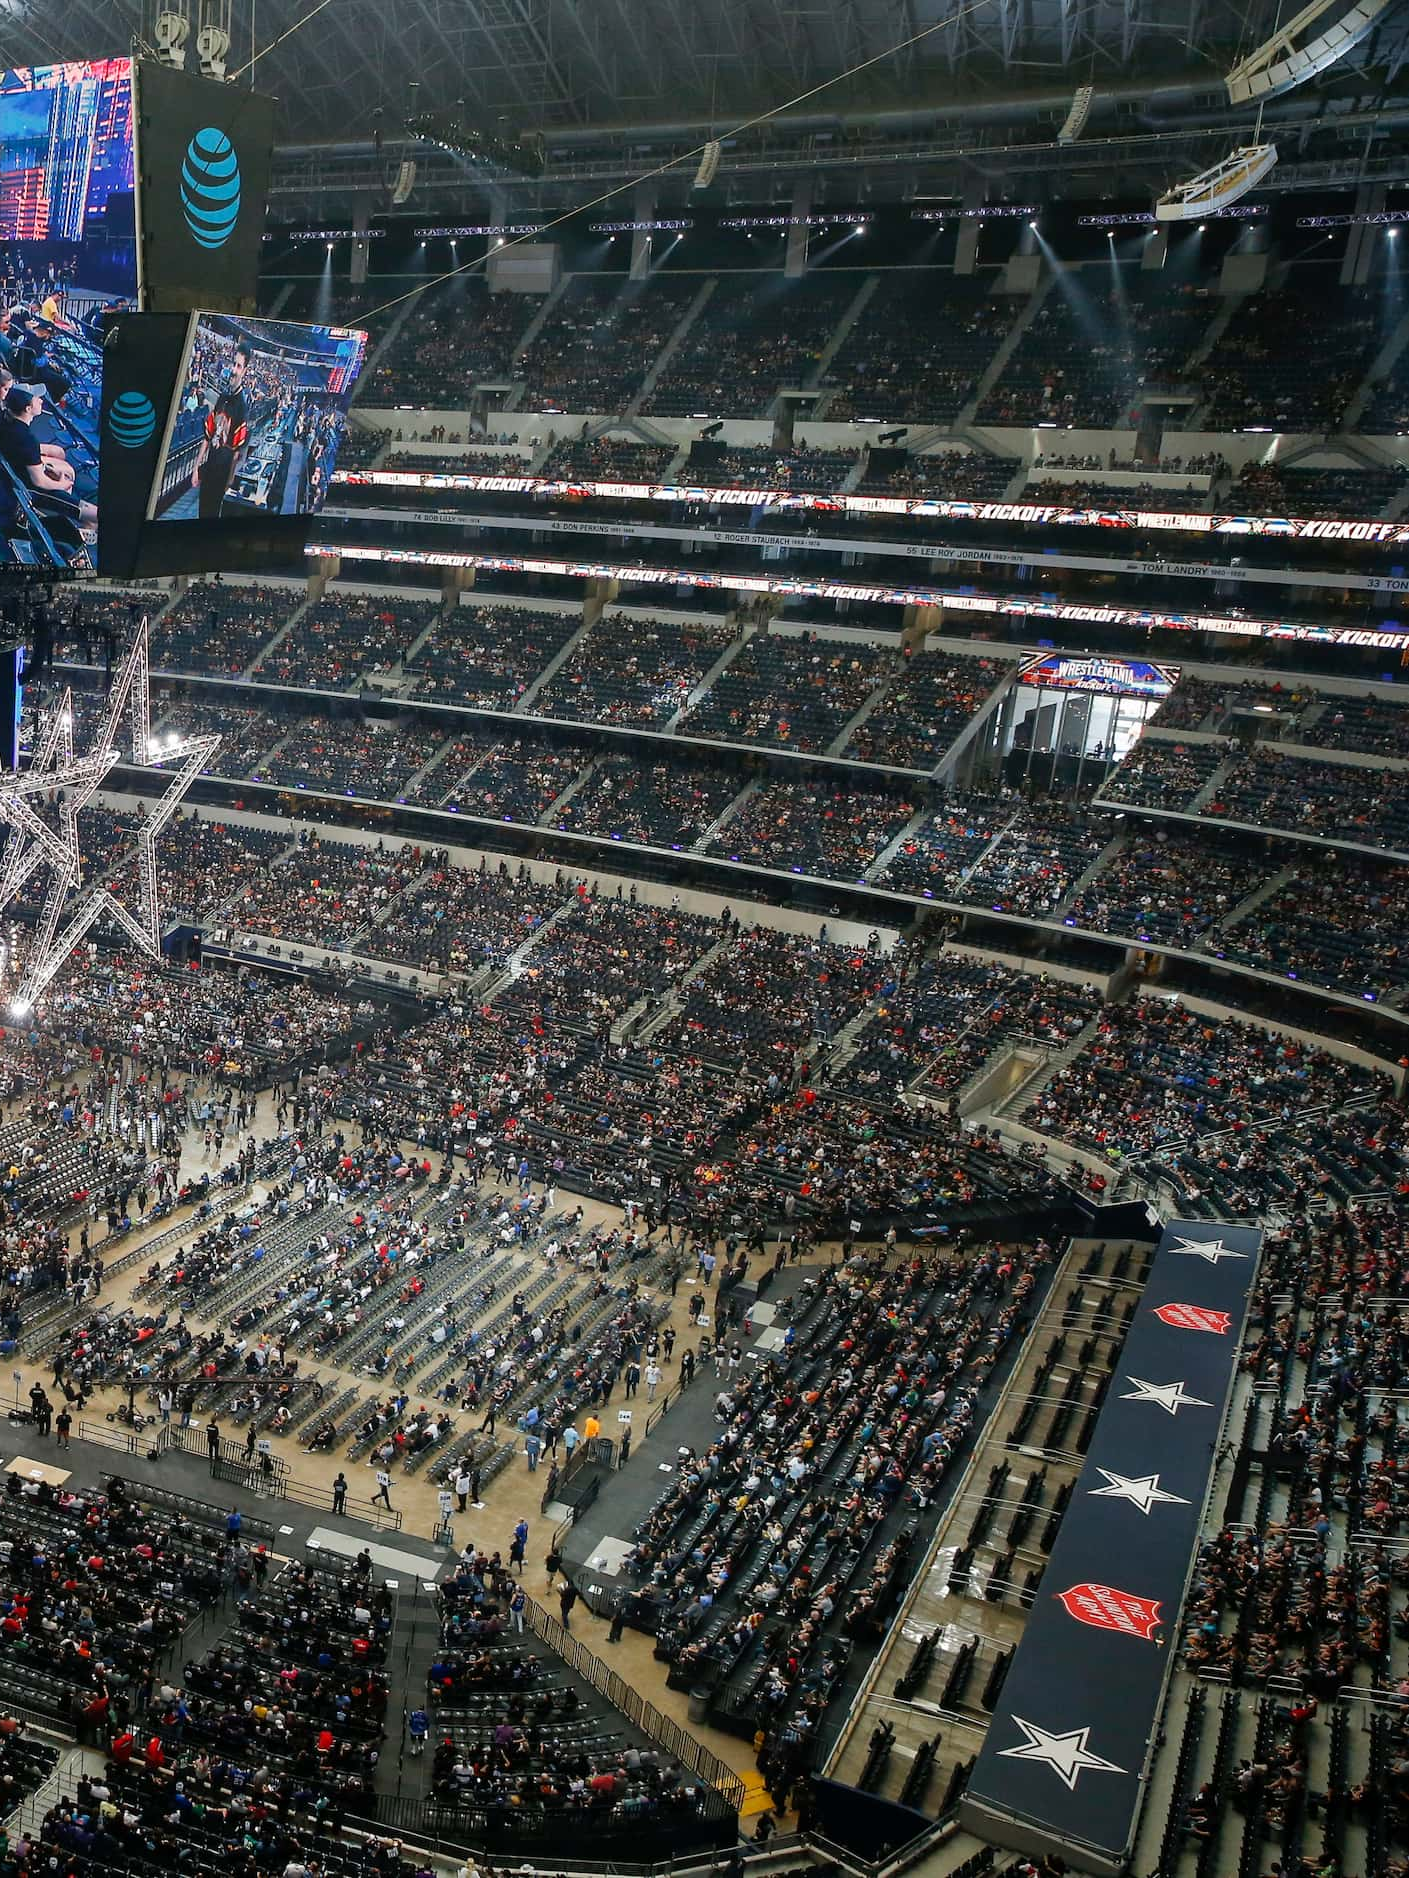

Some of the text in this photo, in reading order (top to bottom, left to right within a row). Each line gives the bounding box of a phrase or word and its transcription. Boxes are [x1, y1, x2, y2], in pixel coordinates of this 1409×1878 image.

[476, 477, 536, 492] KICKOFF
[713, 489, 776, 506] KICKOFF
[979, 504, 1058, 522] KICKOFF
[1137, 511, 1212, 531] WRESTLEMANIA
[1299, 520, 1392, 541] KICKOFF
[725, 534, 750, 543] ROGER
[751, 536, 790, 546] STAUBACH
[428, 554, 473, 567] KICKOFF
[907, 546, 917, 554] 55
[921, 547, 936, 556] LEE
[938, 549, 953, 557] ROY
[956, 550, 991, 560] JORDAN
[617, 568, 667, 582] KICKOFF
[1142, 563, 1163, 574] TOM
[1167, 564, 1208, 576] LANDRY
[1367, 578, 1380, 588] 33
[824, 585, 880, 601] KICKOFF
[1060, 606, 1124, 623] KICKOFF
[1058, 661, 1134, 684] WRESTLEMANIA
[1075, 677, 1113, 693] KICKOFF
